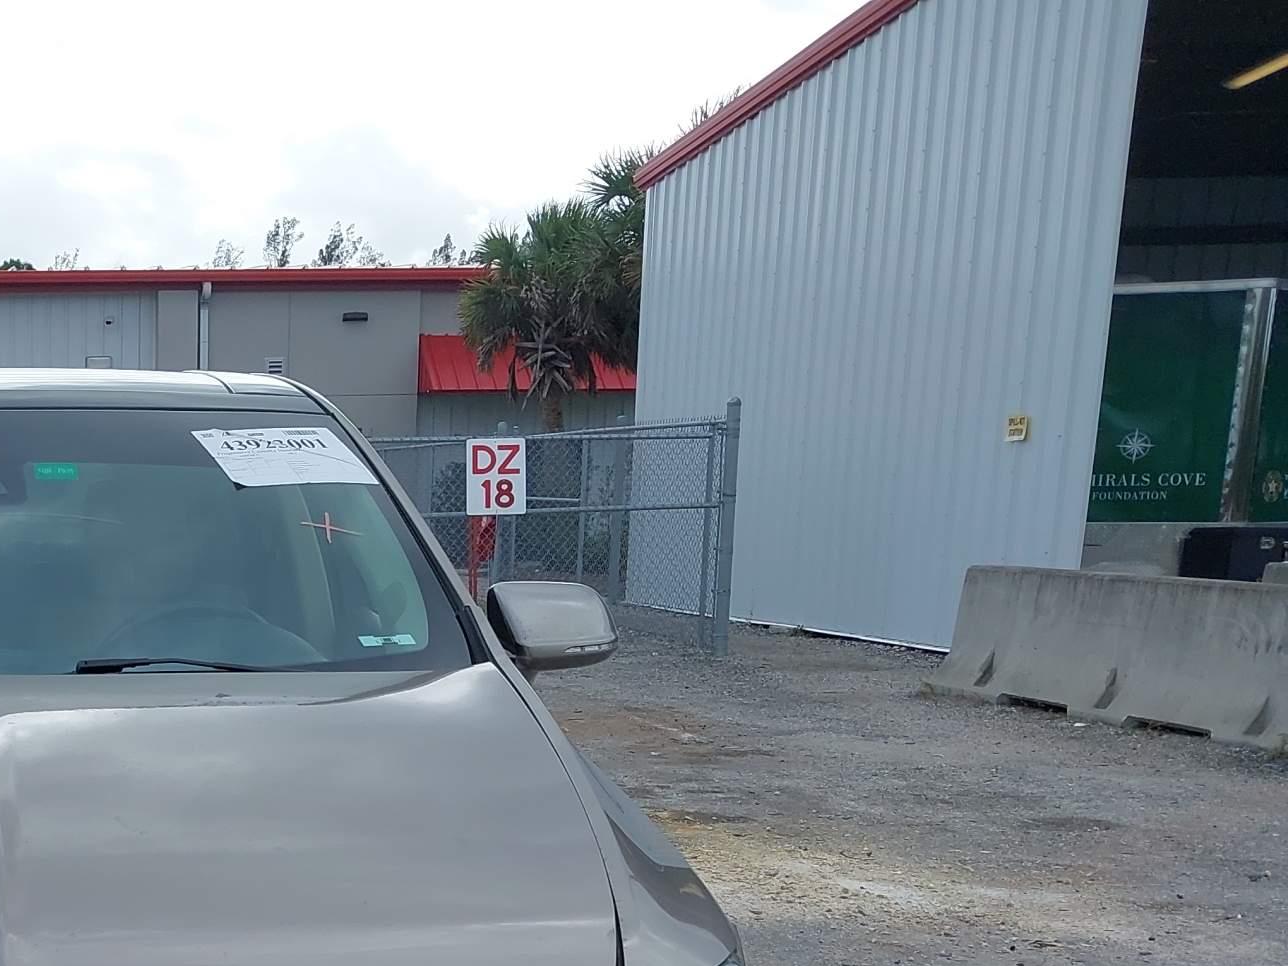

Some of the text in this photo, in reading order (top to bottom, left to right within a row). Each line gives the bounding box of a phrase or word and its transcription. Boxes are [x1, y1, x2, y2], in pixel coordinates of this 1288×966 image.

[220, 437, 328, 452] 43923001
[472, 444, 520, 474] DZ
[1158, 472, 1207, 487] COVE
[481, 478, 515, 508] 18
[1091, 490, 1168, 501] FOUNDATION
